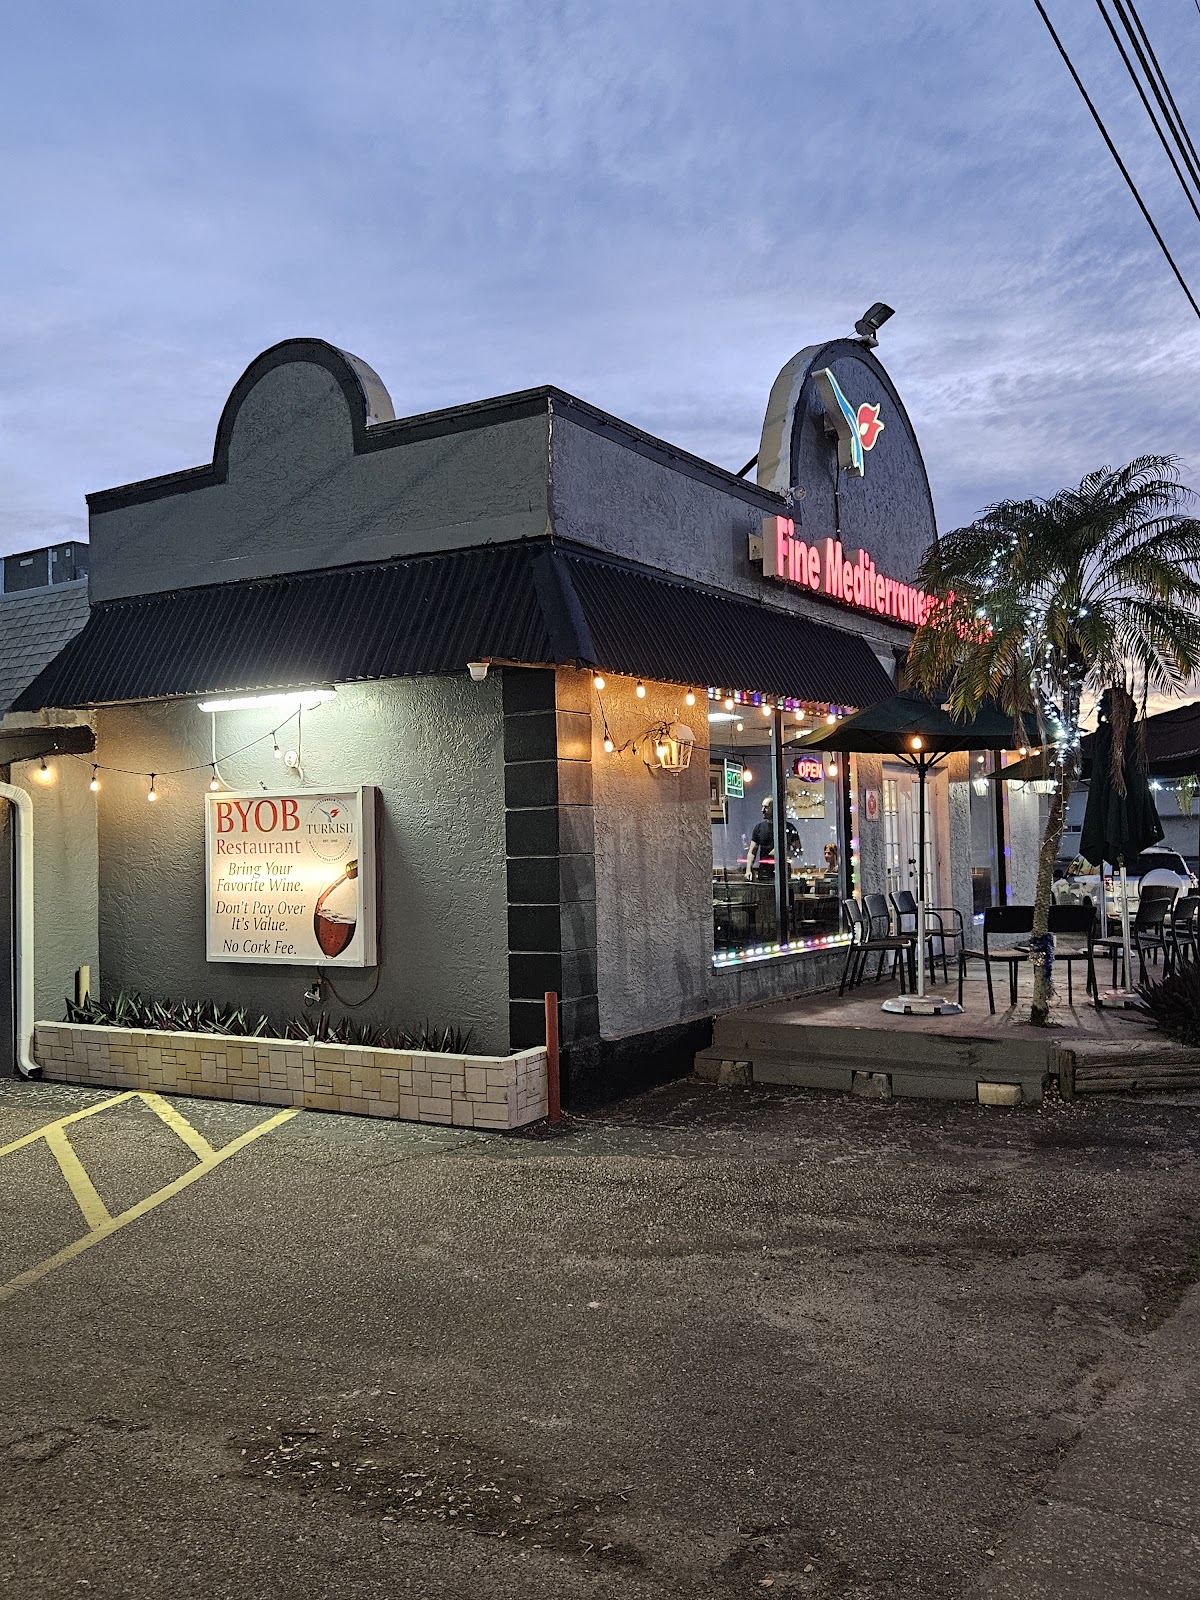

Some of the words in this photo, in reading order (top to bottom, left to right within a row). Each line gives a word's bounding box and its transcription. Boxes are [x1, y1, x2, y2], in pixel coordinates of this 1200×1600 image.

[775, 515, 821, 590] Fine
[798, 762, 823, 779] OPEN
[216, 799, 300, 833] BYOB
[306, 822, 353, 834] TURKISH
[216, 838, 302, 855] Restaurant
[228, 861, 262, 880] Bring
[266, 861, 293, 875] Your
[216, 878, 265, 892] Favorite
[269, 877, 304, 892] Wine.
[216, 900, 249, 914] Don't
[252, 900, 274, 918] Pay
[277, 901, 306, 915] Over
[231, 917, 250, 931] It's
[253, 917, 288, 931] Value.
[222, 939, 239, 953] No
[242, 939, 271, 954] Cork
[274, 940, 297, 955] Fee.
